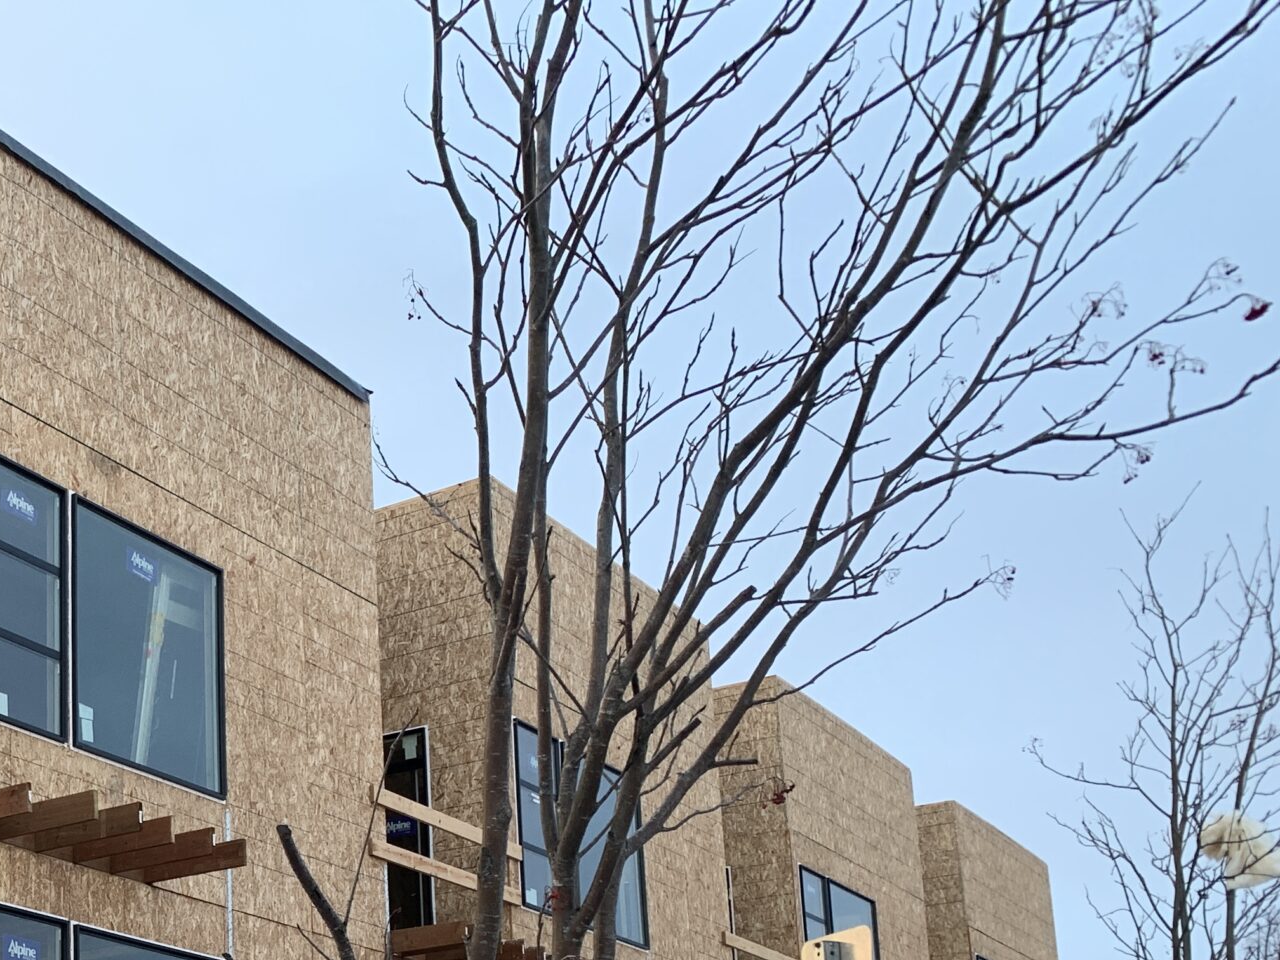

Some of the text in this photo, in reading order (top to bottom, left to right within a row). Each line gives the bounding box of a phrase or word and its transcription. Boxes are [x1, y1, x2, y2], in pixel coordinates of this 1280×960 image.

[7, 490, 35, 514] Alpine
[131, 551, 154, 574] Alpine
[8, 939, 36, 958] Alpine
